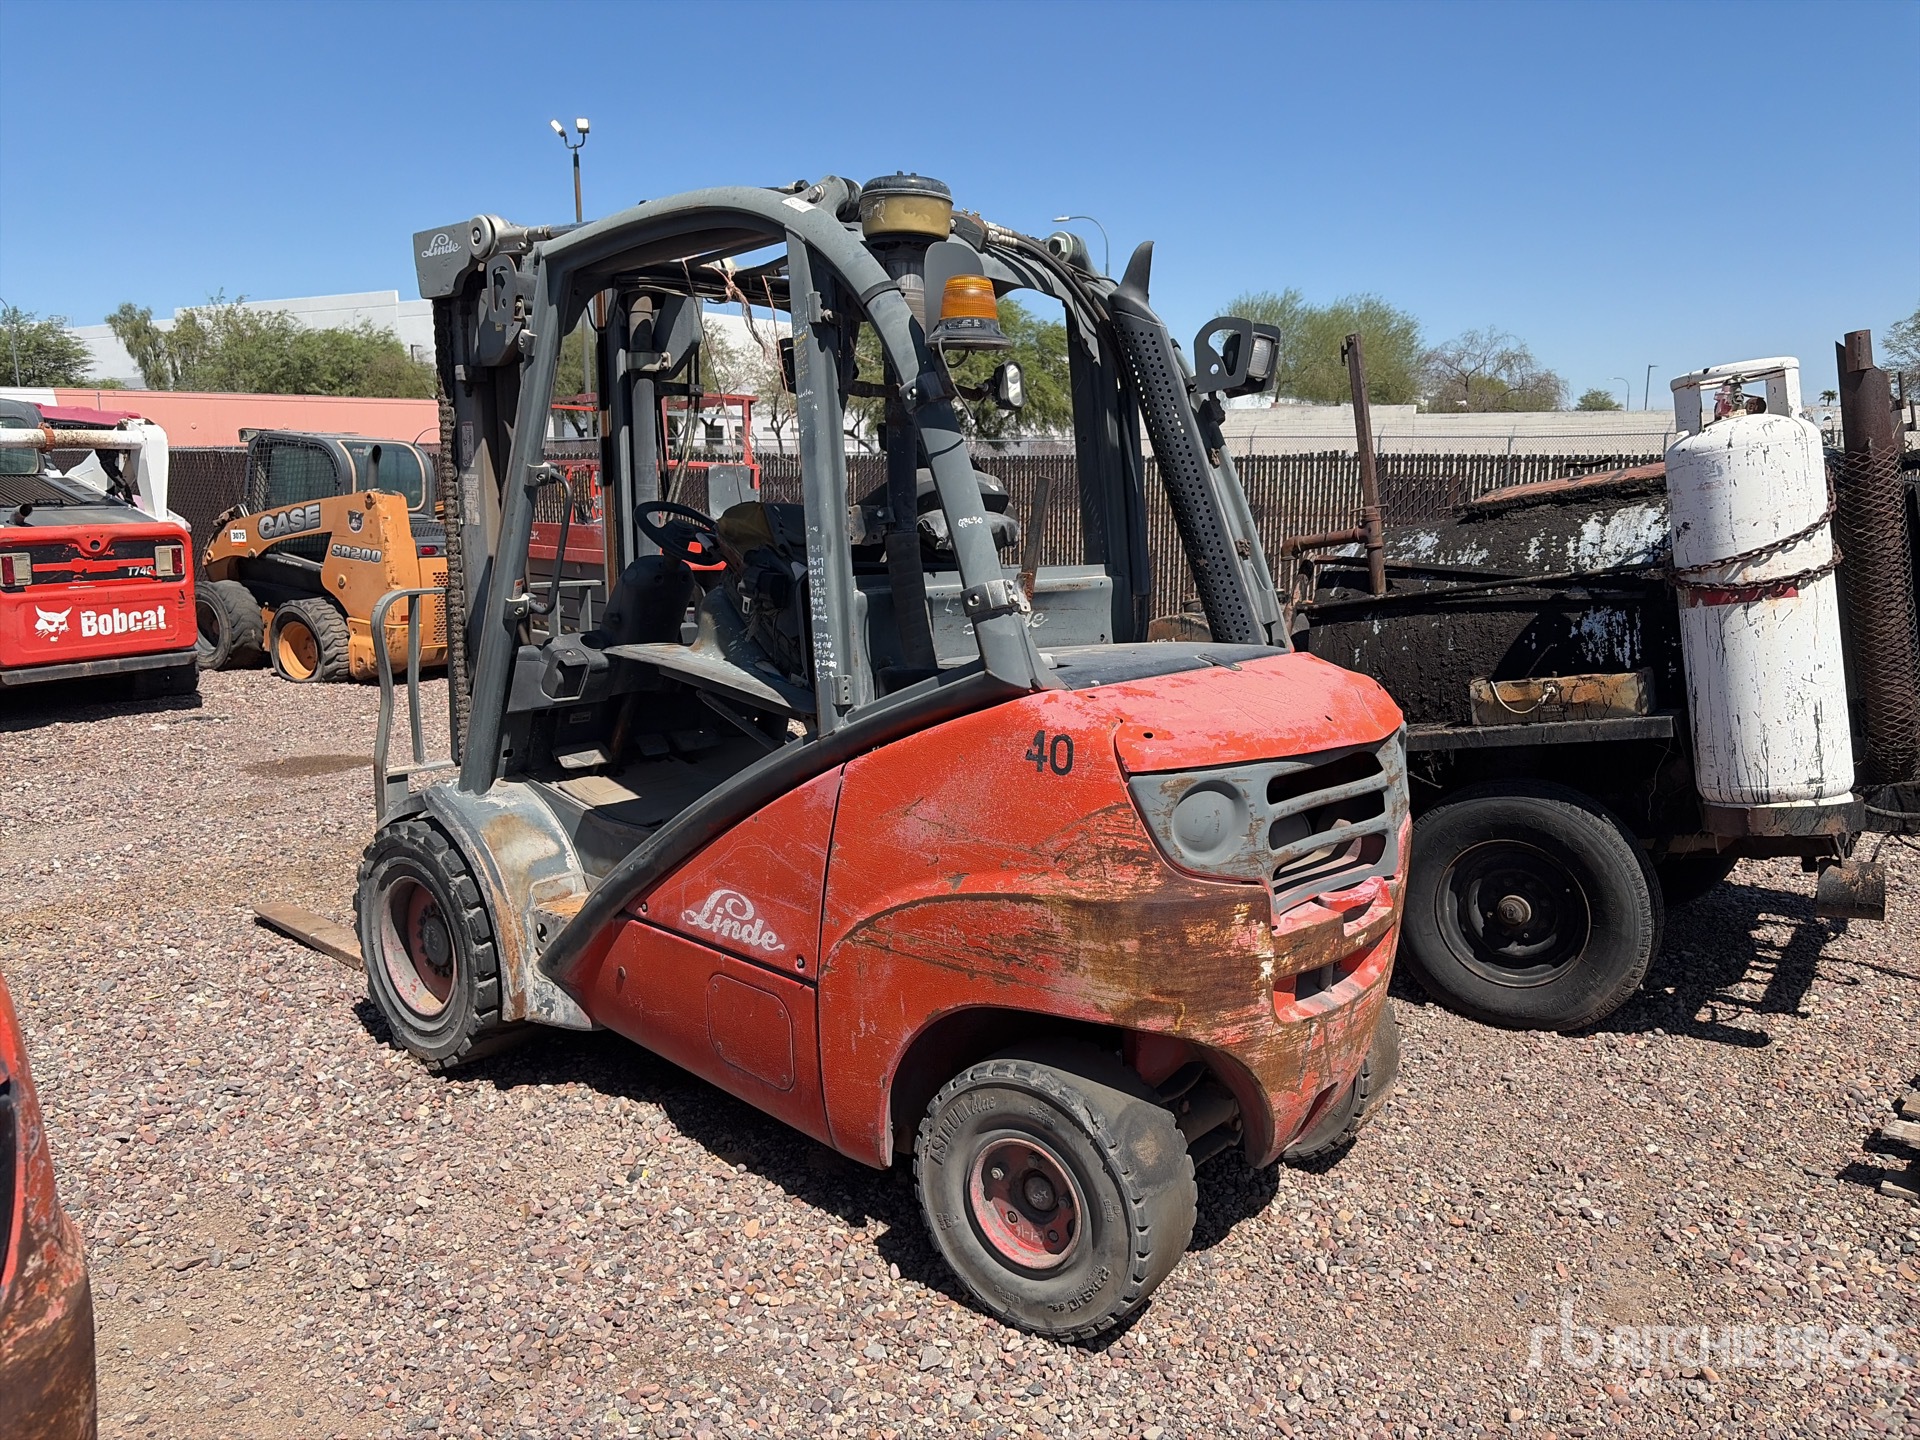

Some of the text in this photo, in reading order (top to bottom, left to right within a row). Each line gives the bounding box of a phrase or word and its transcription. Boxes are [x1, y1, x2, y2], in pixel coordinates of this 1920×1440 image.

[421, 233, 462, 258] Linde
[232, 530, 246, 541] 3075
[258, 502, 321, 540] CASE
[331, 543, 383, 563] SR200
[127, 566, 154, 577] T740
[80, 605, 167, 638] Bobcat
[1025, 729, 1074, 776] 40
[680, 889, 786, 951] Linde
[930, 1100, 972, 1167] ASTRUM
